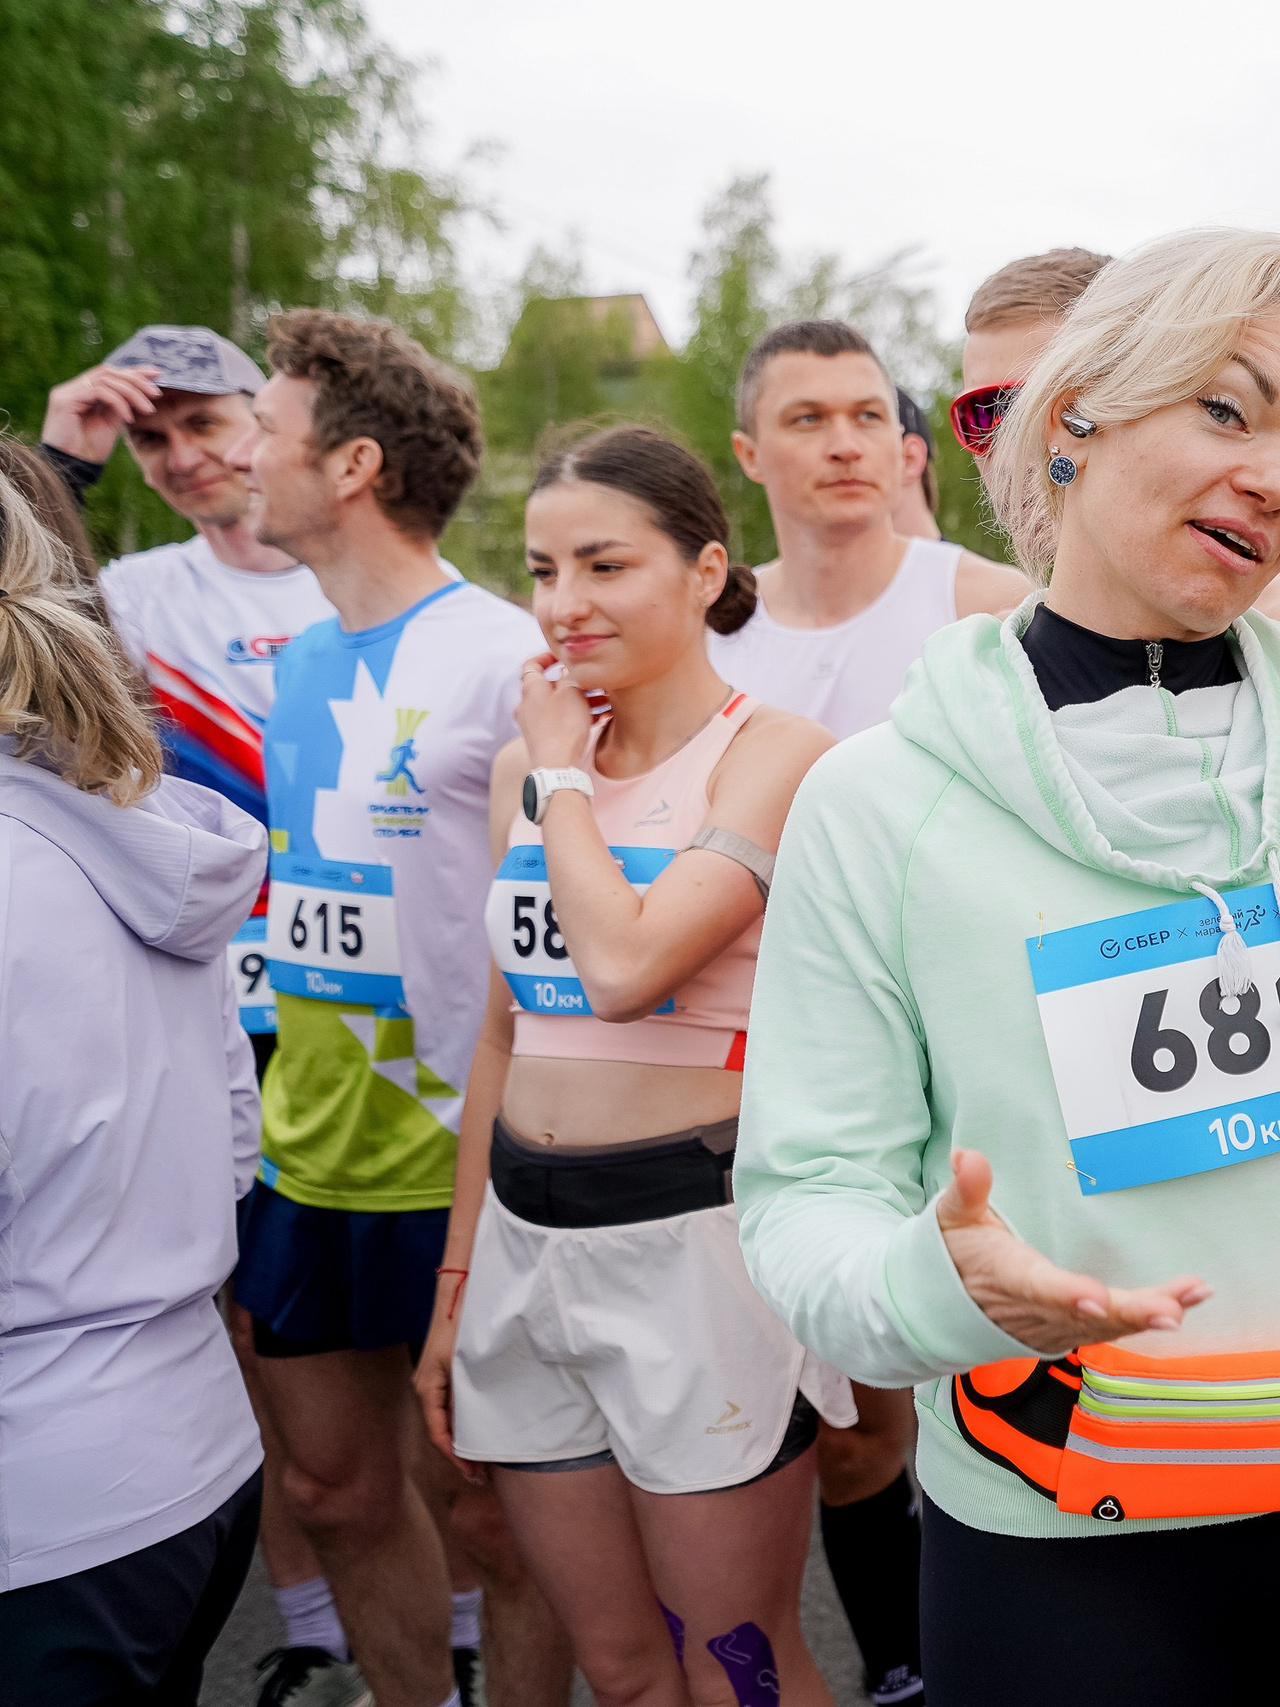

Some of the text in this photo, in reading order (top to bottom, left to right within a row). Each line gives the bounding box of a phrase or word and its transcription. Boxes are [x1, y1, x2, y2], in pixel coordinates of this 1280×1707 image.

[291, 899, 363, 957] 615
[1195, 921, 1242, 937] маран
[1199, 909, 1244, 927] зелёый
[1124, 929, 1171, 951] СБЕР
[533, 983, 557, 1006] 10
[1208, 1112, 1256, 1155] 10
